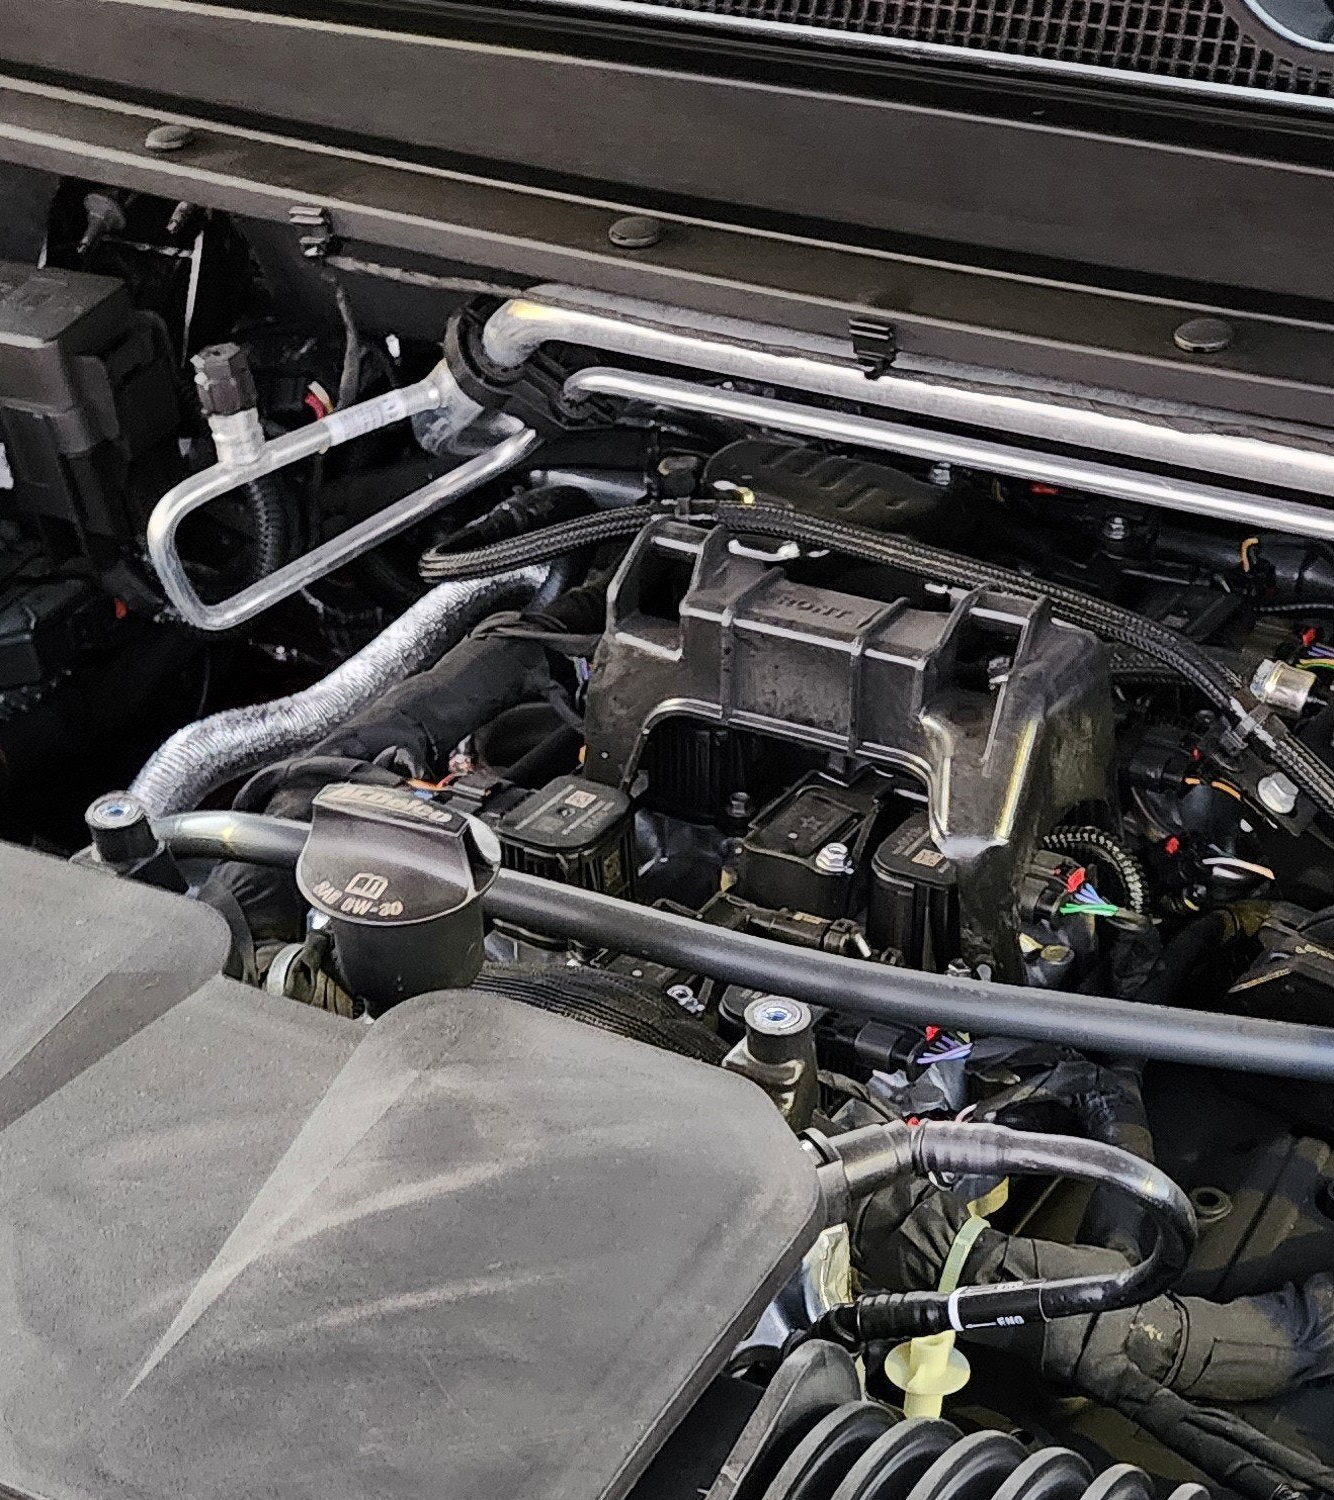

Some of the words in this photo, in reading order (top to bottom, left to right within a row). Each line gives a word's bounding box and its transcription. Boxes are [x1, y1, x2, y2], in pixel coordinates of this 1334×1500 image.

[320, 788, 452, 823] ACDelco
[313, 881, 342, 904] SAE
[996, 1315, 1025, 1326] ENG
